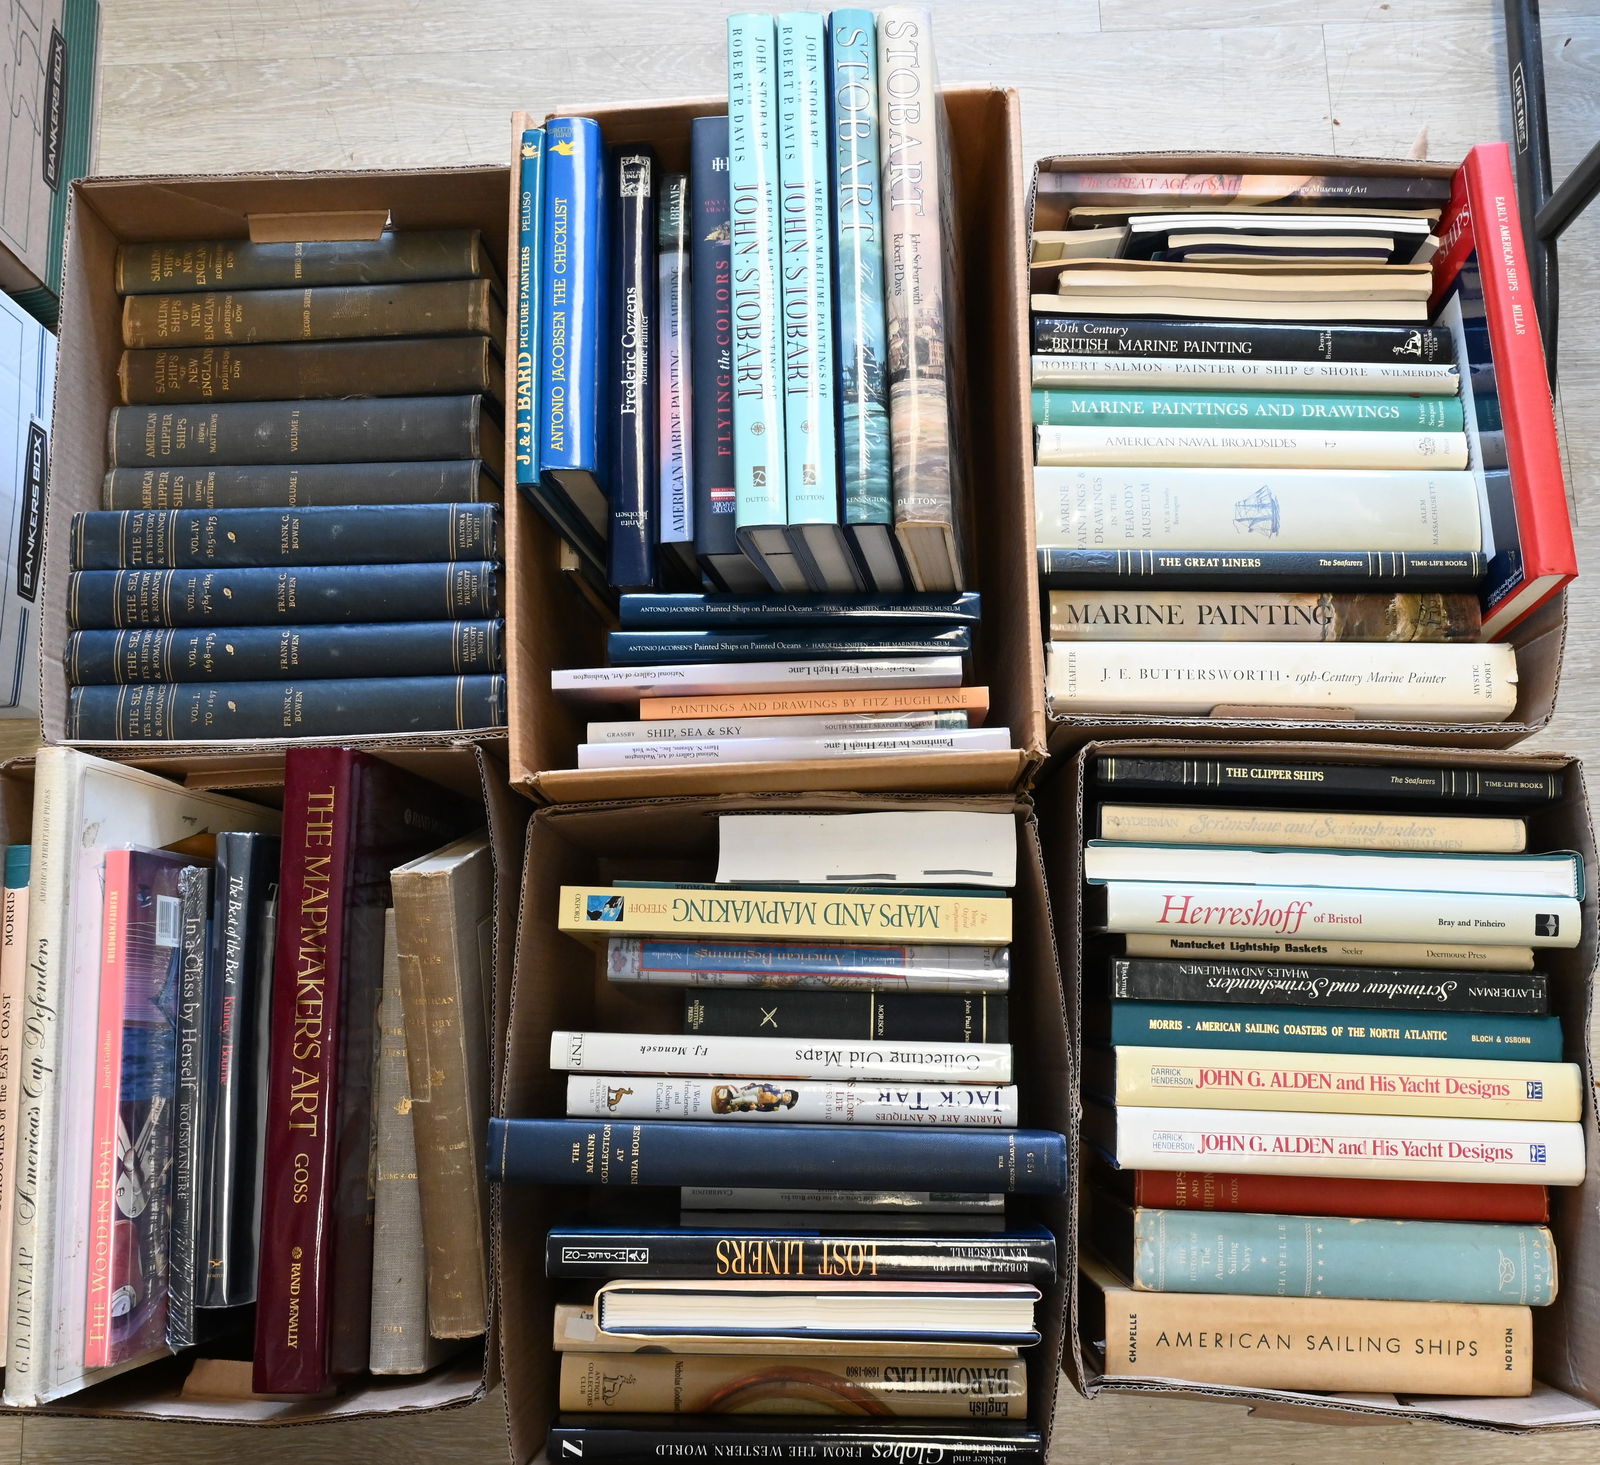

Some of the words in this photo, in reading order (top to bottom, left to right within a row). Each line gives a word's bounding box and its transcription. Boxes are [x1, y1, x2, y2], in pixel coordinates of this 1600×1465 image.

[47, 87, 60, 180] BANKERS
[54, 43, 64, 81] BOX
[885, 20, 925, 217] STOBART
[1514, 75, 1526, 144] LIFETIME
[836, 26, 874, 243] STOBART
[521, 190, 532, 232] PELUSO
[783, 179, 809, 255] JOHN
[814, 179, 823, 242] AMERICAN
[1495, 195, 1509, 223] EARLY
[553, 197, 568, 275] CHECKLIST
[1498, 223, 1515, 267] AMERICAN
[520, 246, 531, 299] PAINTERS
[815, 246, 825, 308] MARITIME
[1505, 266, 1519, 292] SHIPS
[553, 278, 567, 305] THE
[715, 260, 730, 346] COLORS
[158, 297, 170, 338] SAILING
[171, 299, 182, 333] SHIPS
[191, 302, 202, 328] NEW
[235, 304, 243, 323] DOW
[519, 300, 531, 349] PICTURE
[621, 286, 637, 348] Cozzens
[1053, 323, 1079, 334] 20th
[1083, 323, 1129, 337] Century
[1511, 303, 1526, 336] MILLAR
[551, 310, 568, 382] JACOBSEN
[784, 266, 811, 398] STOBART
[817, 312, 827, 380] PAINTINGS
[1051, 337, 1109, 351] BRITISH
[1117, 339, 1179, 352] MARINE
[1183, 340, 1252, 355] PAINTING
[717, 348, 731, 371] the
[1041, 360, 1098, 371] ROBERT
[1104, 361, 1163, 372] SALMON
[1175, 363, 1236, 374] PAINTER
[1242, 365, 1260, 375] OF
[1265, 366, 1298, 376] SHIP
[1303, 367, 1316, 376] &
[1320, 367, 1369, 377] SHORE
[516, 352, 532, 411] BARD
[620, 350, 636, 416] Frederic
[820, 383, 827, 399] OF
[550, 385, 565, 452] ANTONIO
[716, 374, 732, 457] FLYING
[1071, 400, 1145, 414] MARINE
[1152, 401, 1249, 417] PAINTINGS
[1255, 404, 1295, 417] AND
[1302, 404, 1400, 419] DRAWINGS
[145, 412, 158, 459] AMERICAN
[161, 413, 174, 455] CLIPPER
[176, 417, 188, 450] SHIPS
[290, 418, 300, 452] VOLUME
[1104, 437, 1175, 447] AMERICAN
[1178, 437, 1219, 448] NAVAL
[1221, 437, 1297, 449] BROADSIDES
[23, 485, 40, 589] BANKERS
[32, 433, 43, 477] BOX
[133, 512, 145, 534] SEA
[132, 536, 142, 565] THE
[1158, 557, 1181, 567] THE
[1183, 557, 1219, 568] GREAT
[1222, 558, 1261, 568] LINERS
[1332, 559, 1363, 567] Seafarers
[1067, 604, 1184, 625] MARINE
[1197, 604, 1333, 625] PAINTING
[1119, 668, 1131, 680] E.
[1139, 668, 1280, 681] BUTTERSWORTH
[1294, 670, 1363, 686] 19th-Century
[1367, 671, 1404, 684] Marine
[1408, 671, 1446, 684] Painter
[671, 704, 735, 715] PAINTINGS
[740, 702, 767, 712] AND
[772, 700, 838, 711] DRAWINGS
[842, 699, 857, 707] BY
[863, 698, 889, 707] FITZ
[894, 696, 932, 705] HUGH
[937, 695, 968, 705] LANE
[647, 728, 677, 738] SHIP,
[680, 728, 703, 737] SEA
[706, 727, 715, 736] &
[719, 726, 742, 736] SKY
[1226, 767, 1249, 778] THE
[1250, 768, 1292, 780] CLIPPER
[1293, 770, 1325, 782] SHIPS
[305, 785, 336, 848] THE
[4, 891, 16, 946] MORRIS
[184, 917, 201, 935] In
[628, 903, 668, 914] STEFOFF
[673, 898, 817, 925] MAPMAKING
[823, 902, 875, 926] AND
[879, 903, 940, 929] MAPS
[1156, 894, 1313, 934] Herreshoff
[1313, 912, 1326, 924] of
[1328, 913, 1363, 925] Bristol
[1438, 918, 1455, 928] Bray
[1457, 918, 1471, 927] and
[1474, 918, 1506, 928] Pinheiro
[292, 854, 331, 1061] MAPMAKER'S
[1170, 938, 1226, 950] Nantucket
[1230, 941, 1280, 953] Lightship
[1285, 943, 1328, 954] Baskets
[183, 951, 201, 999] Class
[23, 938, 57, 1050] Defenders
[180, 1002, 201, 1024] by
[1149, 1019, 1183, 1031] MORRIS
[1195, 1021, 1241, 1033] AMERICAN
[1245, 1023, 1280, 1034] SAILING
[1283, 1024, 1327, 1036] COASTERS
[1332, 1026, 1343, 1037] OF
[1347, 1027, 1366, 1038] THE
[1369, 1028, 1400, 1039] NORTH
[1404, 1029, 1448, 1041] ATLANTIC
[1471, 1034, 1494, 1043] BLOCH
[1496, 1035, 1502, 1043] &
[1504, 1035, 1531, 1044] OSBORN
[22, 1056, 53, 1099] Cup
[180, 1026, 198, 1094] Herself
[1195, 1069, 1243, 1089] JOHN
[1247, 1070, 1265, 1087] G.
[1270, 1071, 1332, 1090] ALDEN
[1336, 1075, 1365, 1091] and
[1369, 1075, 1397, 1092] His
[1399, 1076, 1441, 1094] Yacht
[1445, 1078, 1511, 1099] Designs
[288, 1066, 320, 1138] ART
[176, 1103, 192, 1201] ROUSMANIERE
[571, 1142, 582, 1164] THE
[586, 1132, 597, 1174] MARINE
[601, 1124, 612, 1184] COLLECTION
[631, 1125, 641, 1157] HOUSE
[17, 1106, 41, 1226] America's
[95, 1139, 113, 1196] BOAT
[293, 1152, 310, 1205] GOSS
[630, 1158, 640, 1185] INDIA
[91, 1199, 111, 1295] WOODEN
[716, 1239, 804, 1275] LINERS
[818, 1241, 879, 1276] LOST
[16, 1246, 33, 1323] DUNLAP
[88, 1301, 106, 1347] THE
[1129, 1312, 1137, 1364] CHAPELLE
[1155, 1331, 1292, 1350] AMERICAN
[1306, 1335, 1402, 1354] SAILING
[1415, 1338, 1478, 1357] SHIPS
[1505, 1328, 1513, 1371] NORTON
[969, 1400, 1010, 1416] English
[655, 1444, 707, 1456] WORLD
[714, 1444, 783, 1457] WESTERN
[788, 1446, 816, 1458] THE
[822, 1446, 863, 1458] FROM
[871, 1442, 945, 1465] Globes
